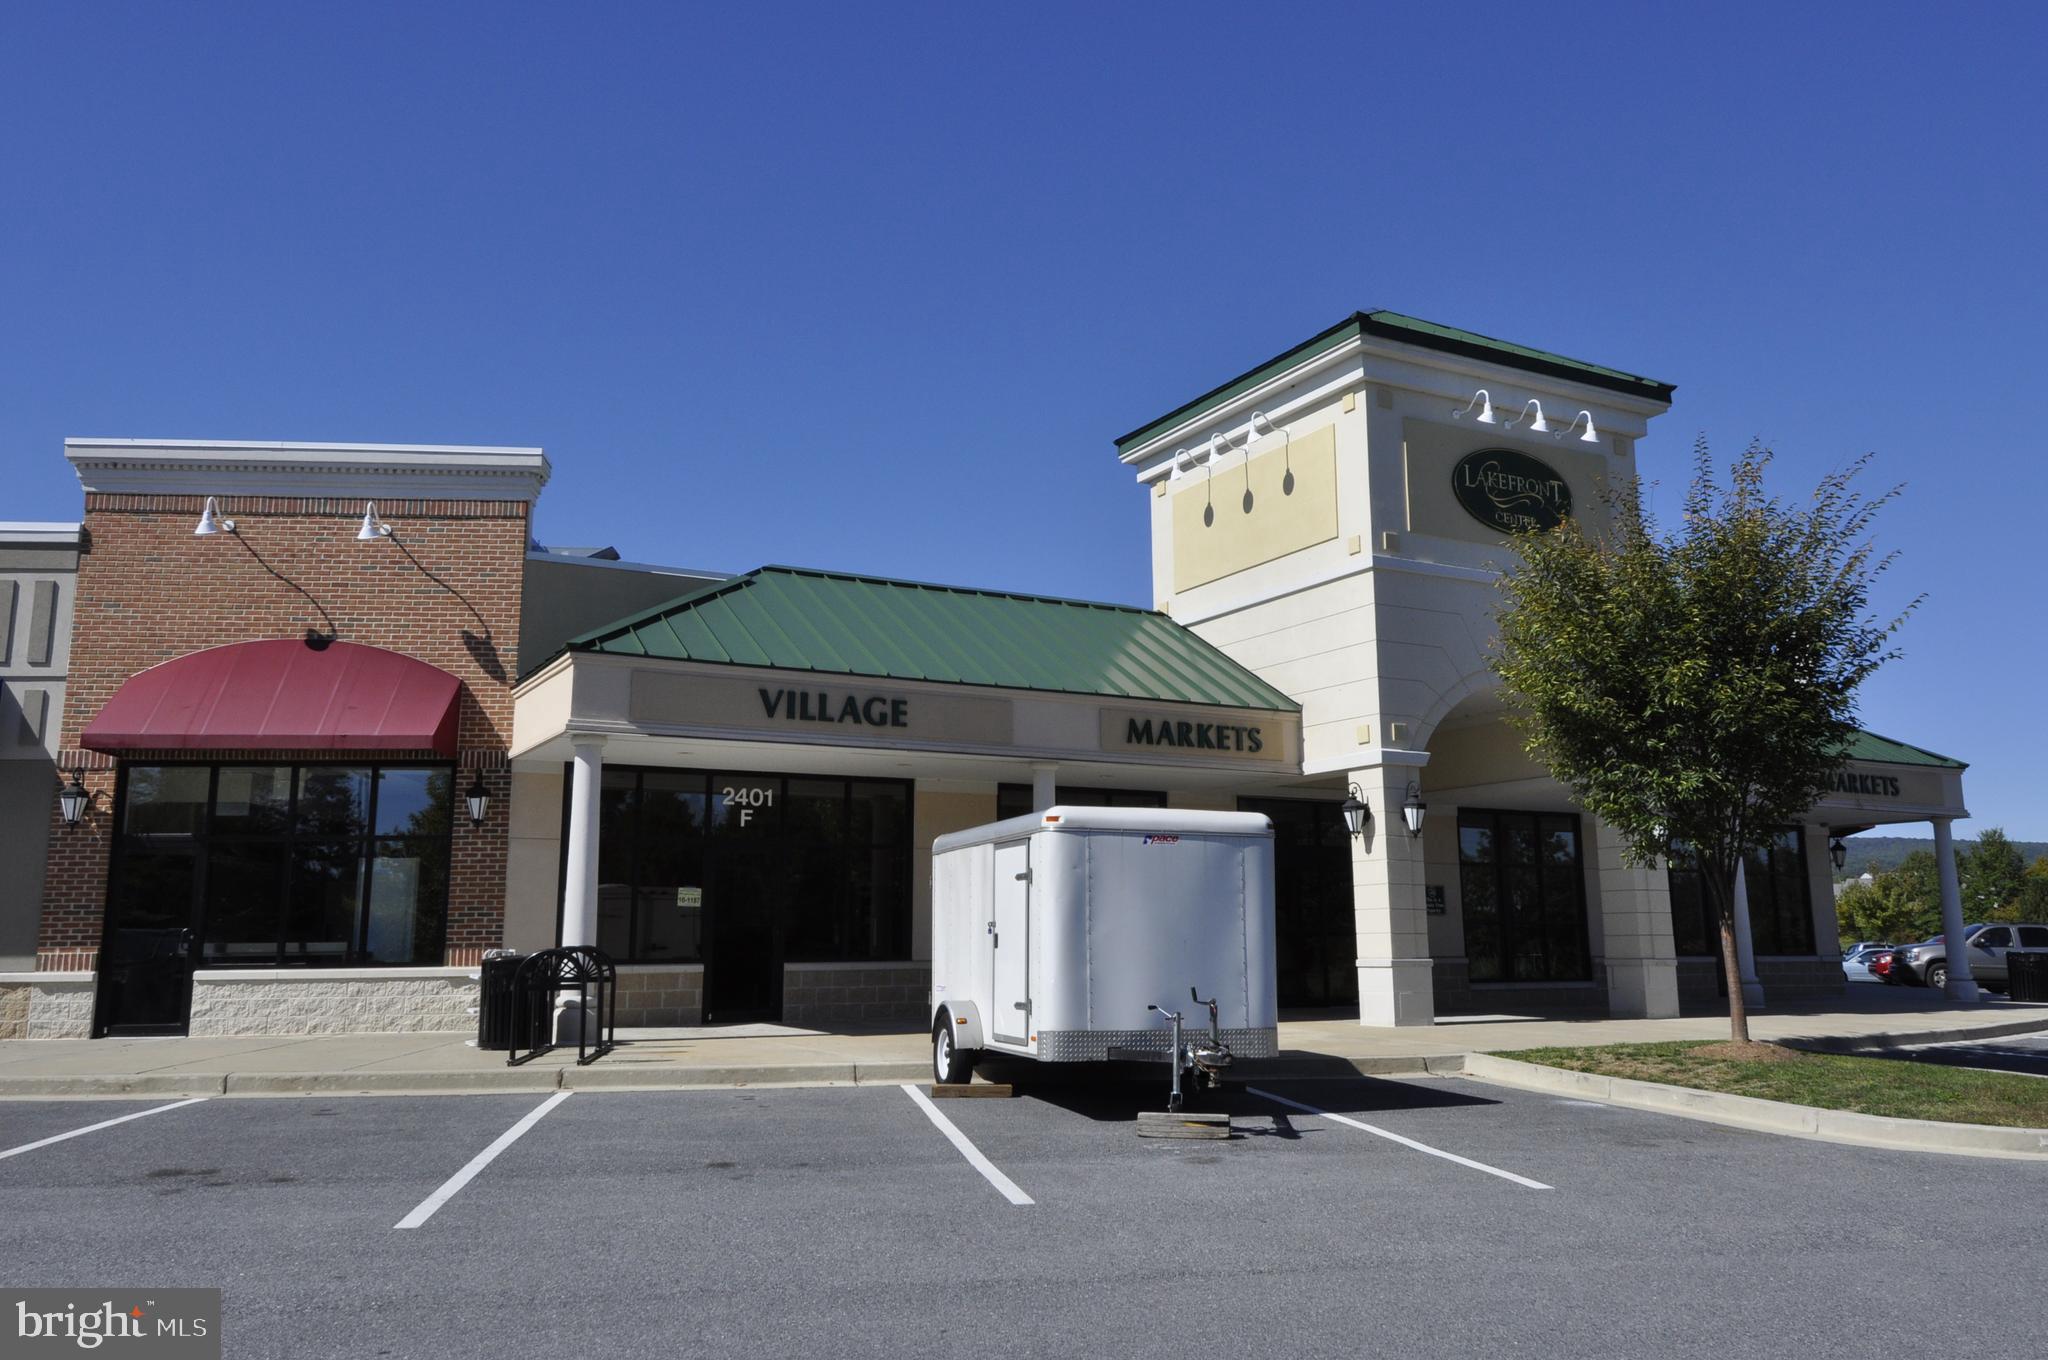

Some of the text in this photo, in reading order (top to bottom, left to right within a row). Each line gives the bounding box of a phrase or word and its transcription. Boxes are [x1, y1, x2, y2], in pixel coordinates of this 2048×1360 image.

[1463, 462, 1563, 504] LAKEFRONT
[758, 688, 908, 727] VILLAGE
[1126, 718, 1263, 752] MARKETS
[722, 787, 773, 807] 2401
[740, 809, 754, 828] F
